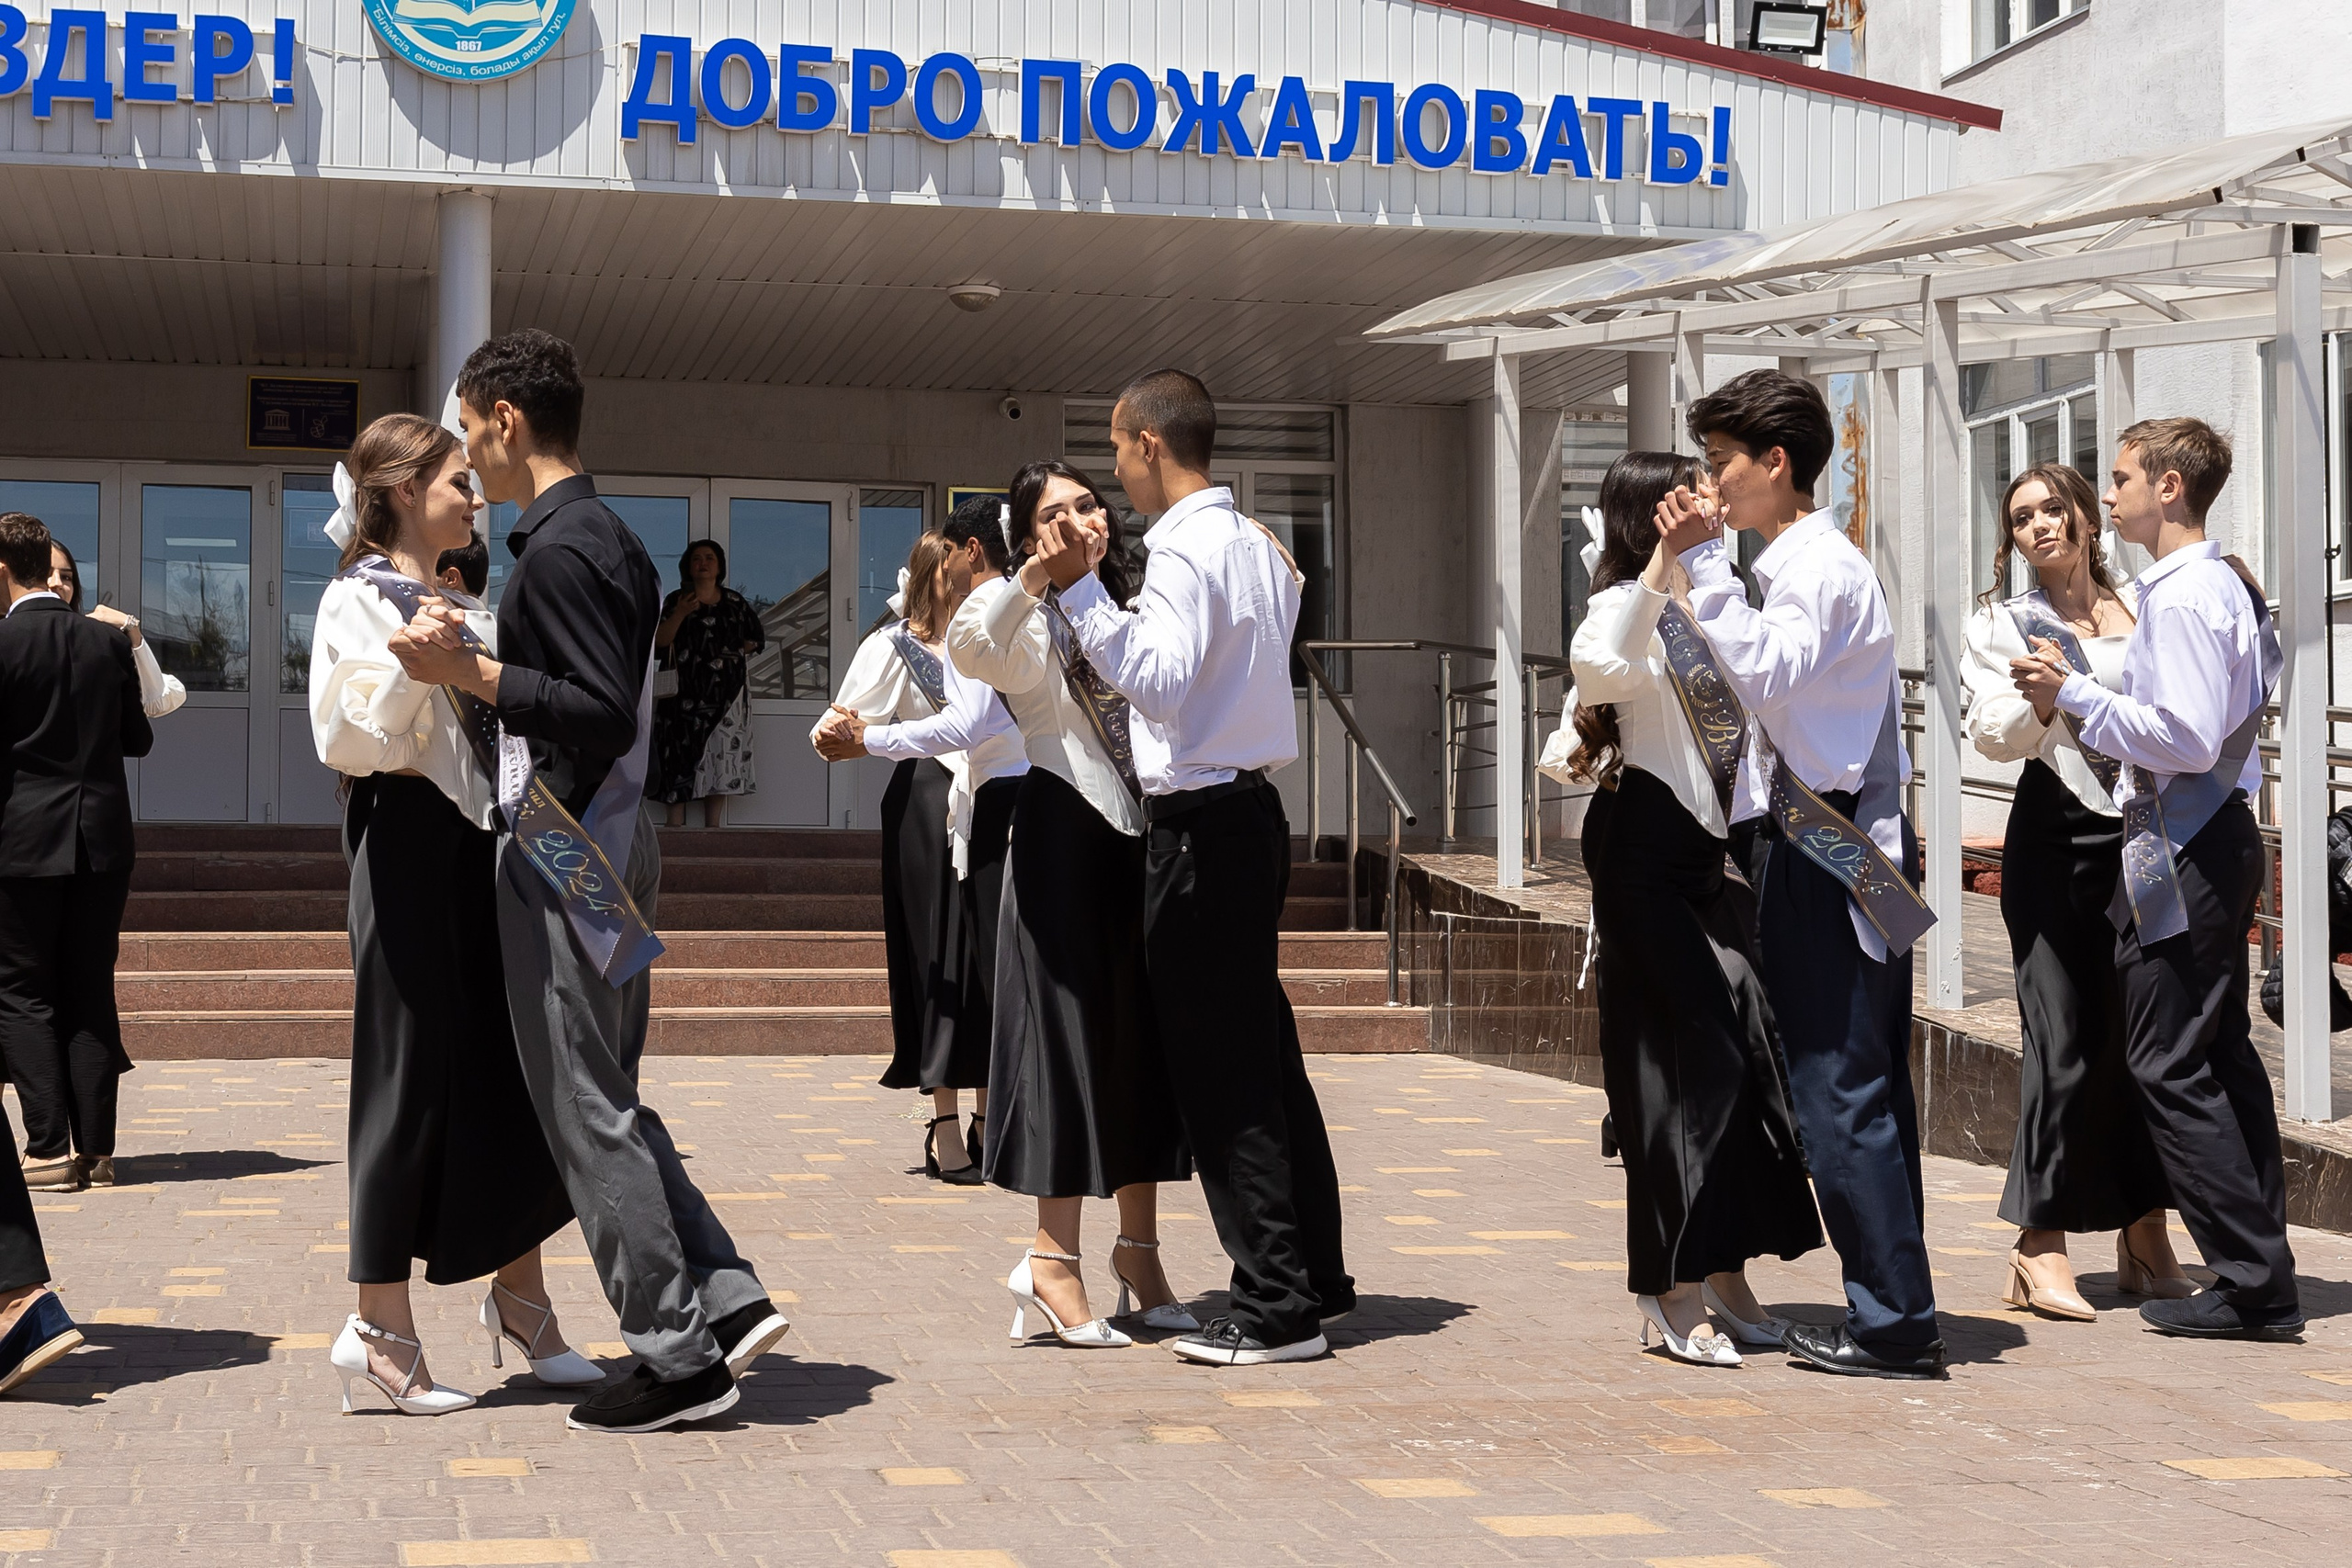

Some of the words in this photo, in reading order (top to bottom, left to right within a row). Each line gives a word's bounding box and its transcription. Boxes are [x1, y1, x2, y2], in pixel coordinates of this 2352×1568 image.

[455, 40, 482, 51] 1867
[470, 59, 520, 75] болады
[523, 35, 549, 61] ақыл
[620, 34, 983, 145] ДОБРО
[1019, 59, 1731, 188] ПОЖАЛОВАТЬ!
[530, 829, 626, 915] 2024
[1804, 826, 1899, 895] 2024
[2129, 807, 2169, 889] 2024
